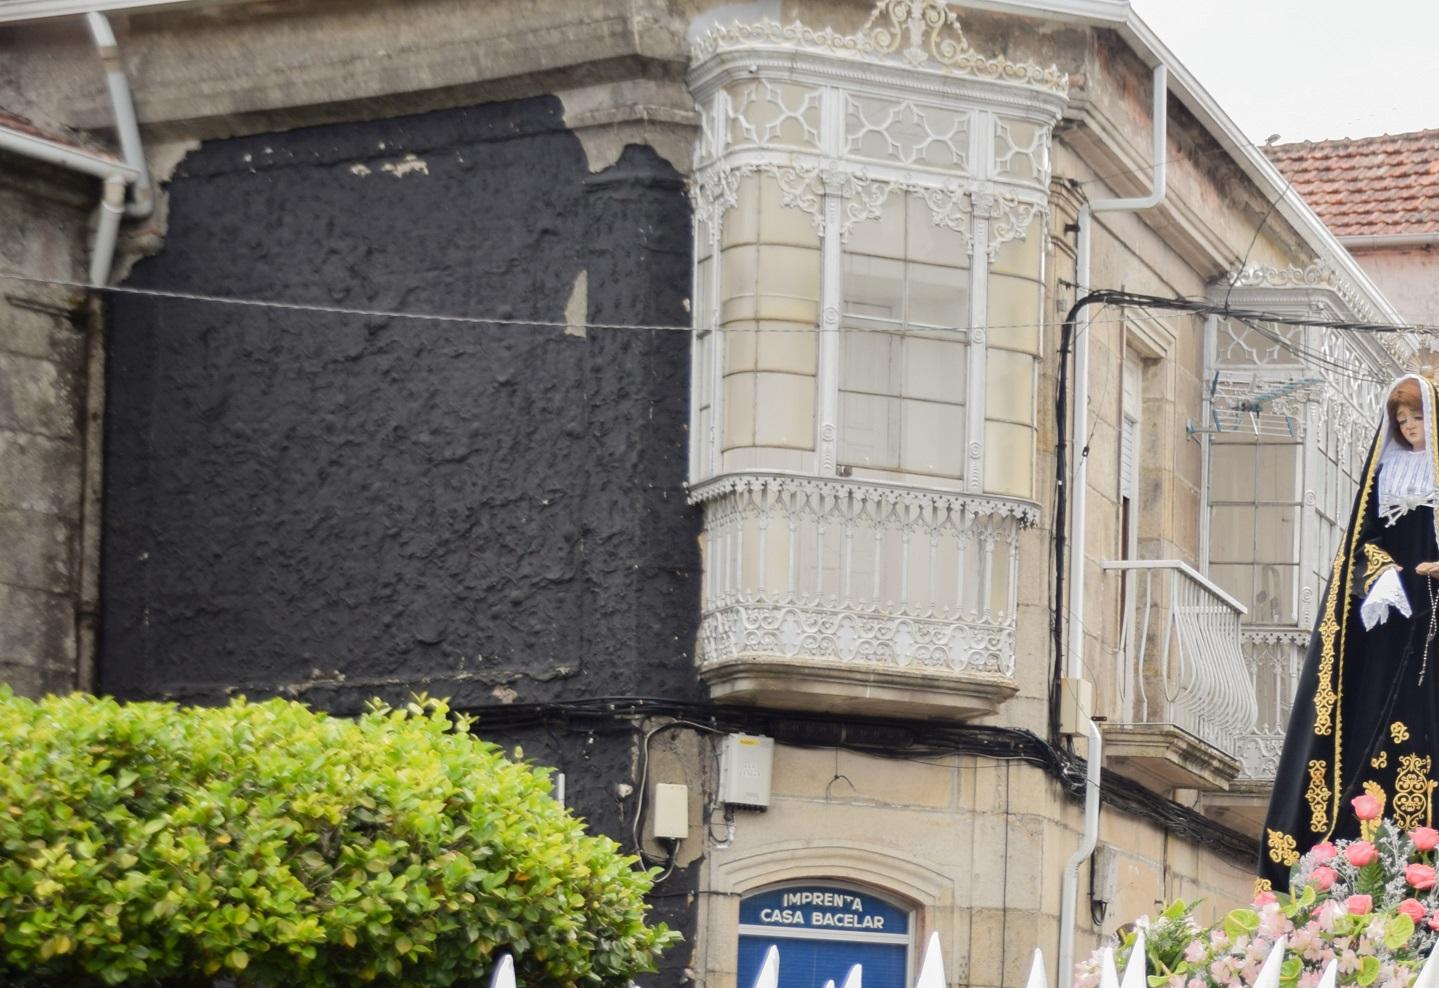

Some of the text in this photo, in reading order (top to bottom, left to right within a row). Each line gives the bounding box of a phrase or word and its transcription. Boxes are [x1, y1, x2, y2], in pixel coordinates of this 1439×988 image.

[783, 892, 863, 912] IMPRENTA
[760, 908, 885, 929] CASA BACELAR
